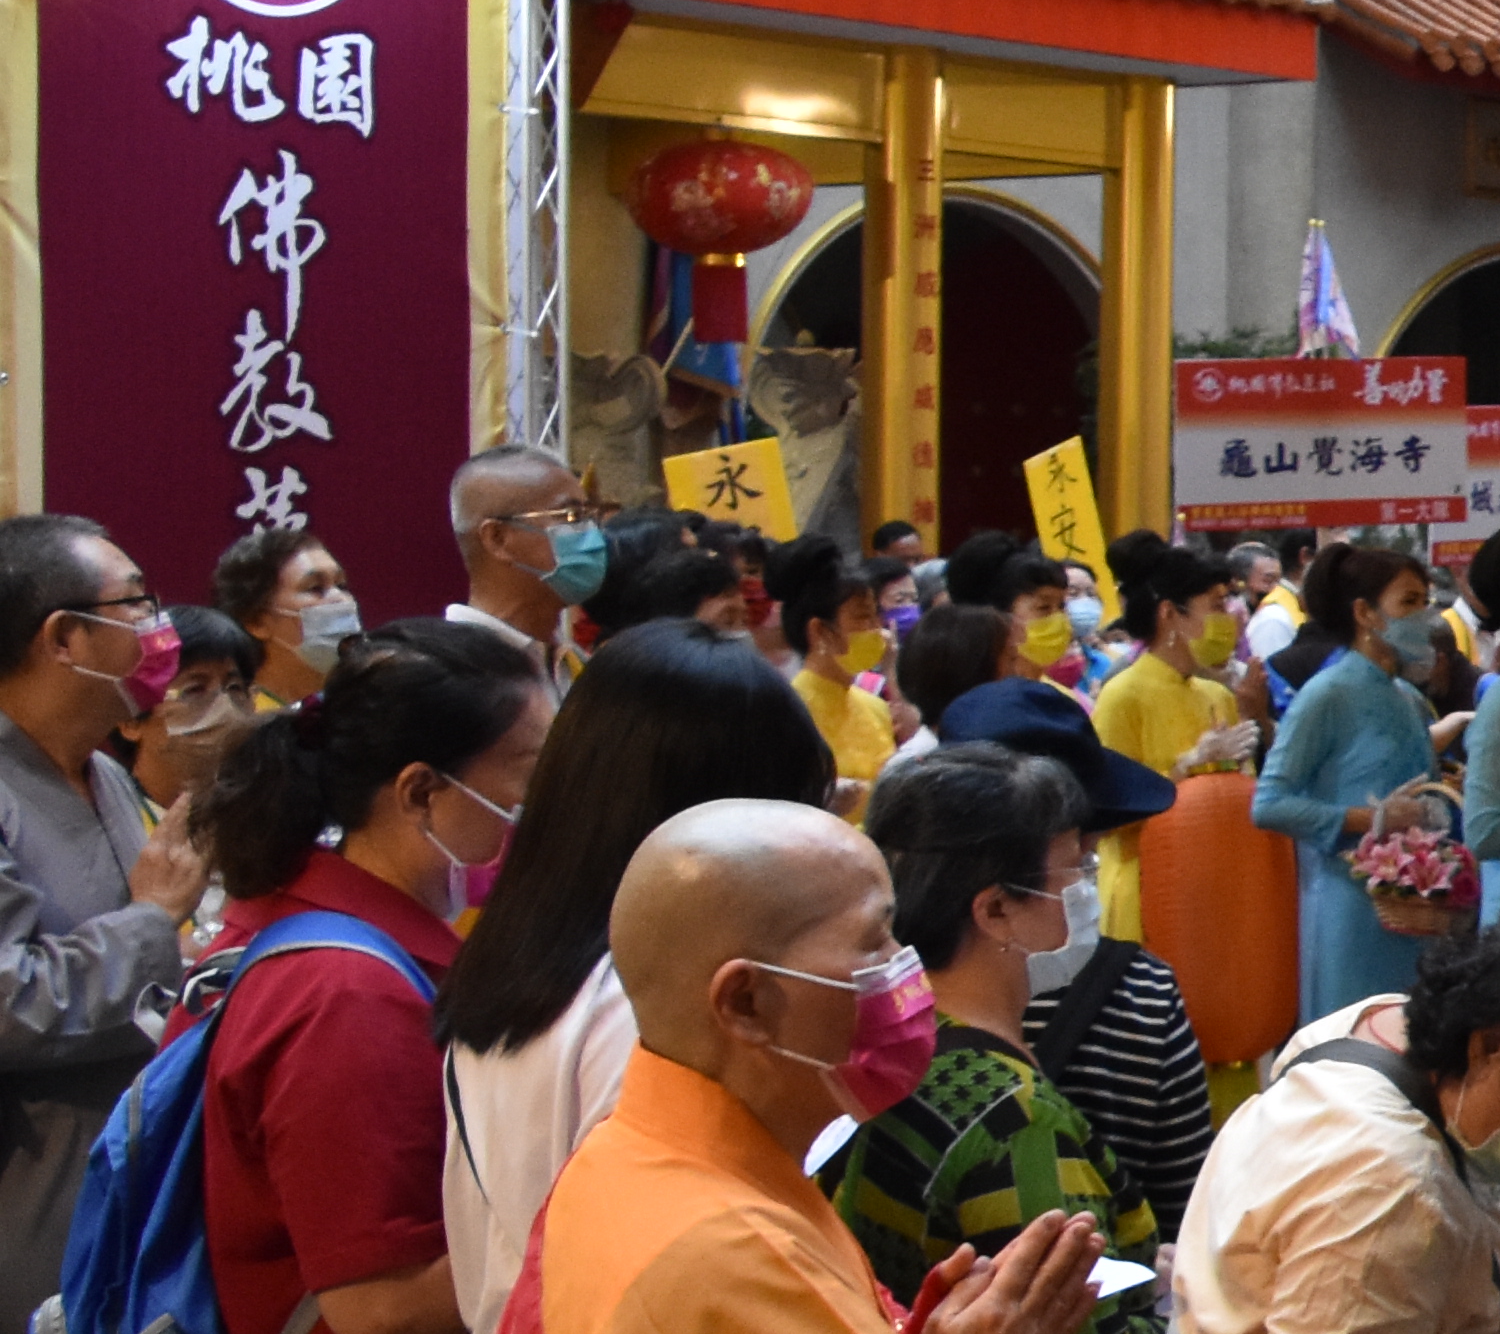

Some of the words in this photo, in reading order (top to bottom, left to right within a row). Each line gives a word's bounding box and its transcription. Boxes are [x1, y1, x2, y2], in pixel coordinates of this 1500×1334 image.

[166, 16, 375, 137] 桃園
[705, 454, 764, 531] 永
[1220, 434, 1431, 478] 龜山覺海寺
